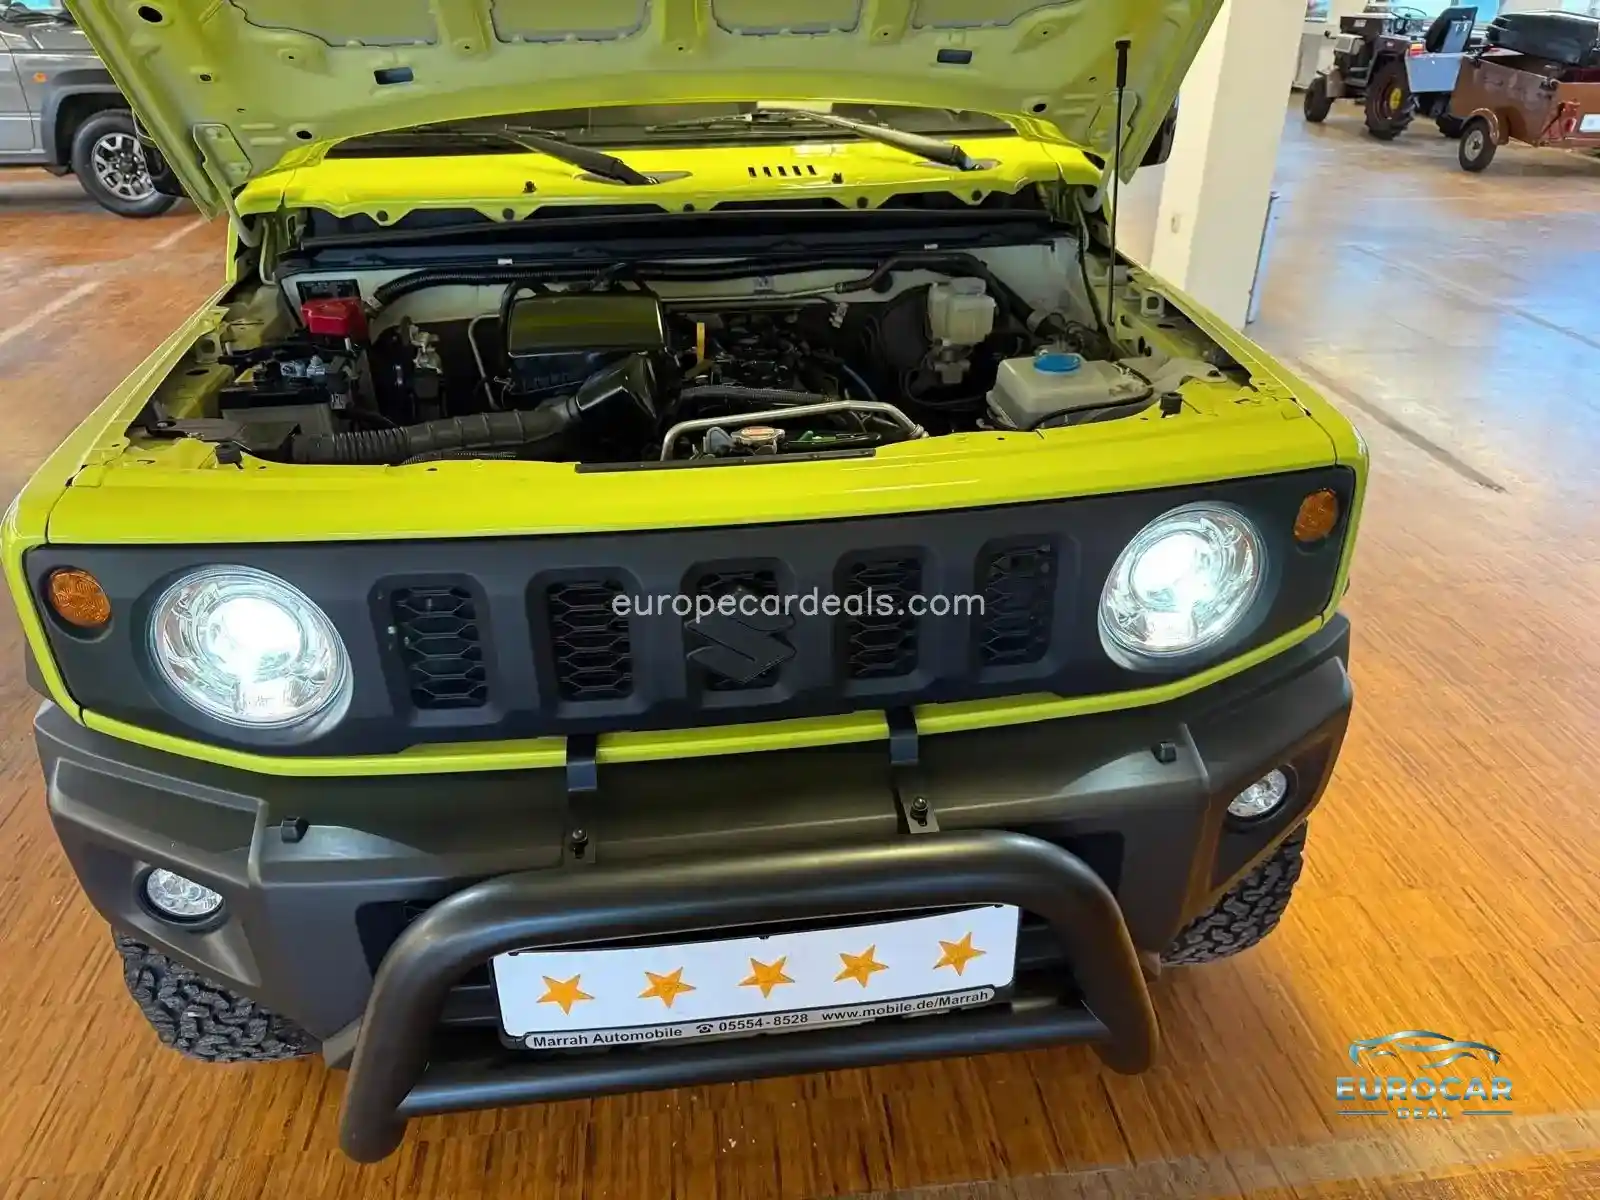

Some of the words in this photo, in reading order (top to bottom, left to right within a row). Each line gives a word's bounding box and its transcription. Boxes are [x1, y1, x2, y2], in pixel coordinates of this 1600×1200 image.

[533, 1034, 588, 1047] Marrah
[593, 1027, 683, 1044] Automobile
[822, 991, 988, 1021] www.mobile.de/Marrah
